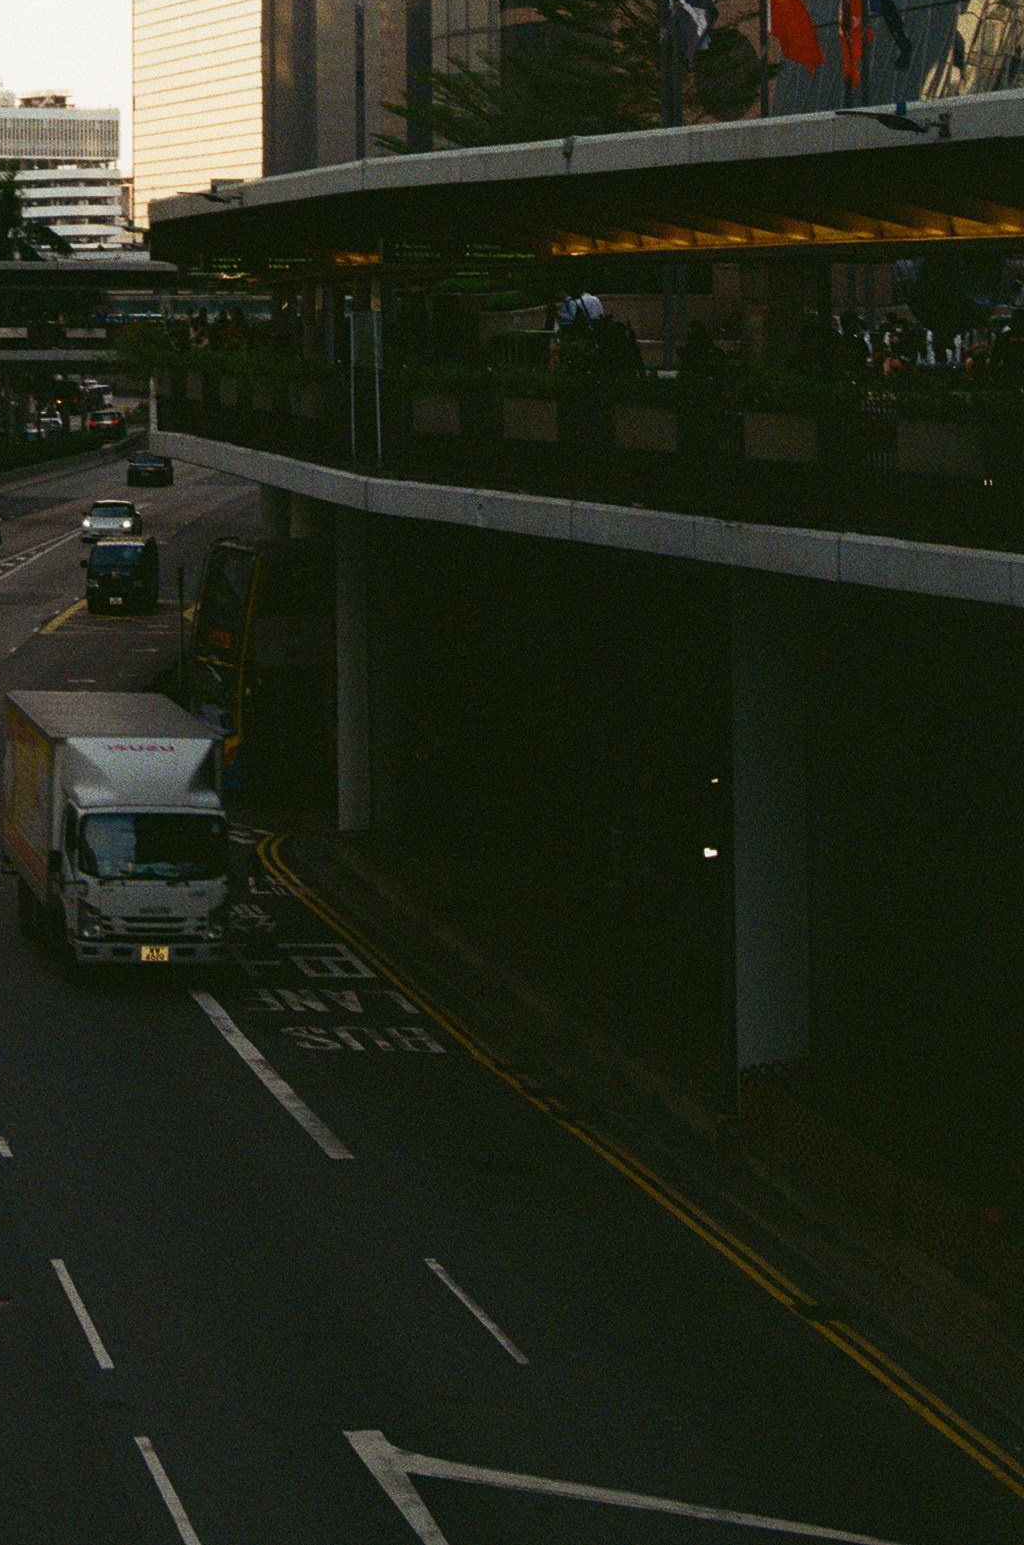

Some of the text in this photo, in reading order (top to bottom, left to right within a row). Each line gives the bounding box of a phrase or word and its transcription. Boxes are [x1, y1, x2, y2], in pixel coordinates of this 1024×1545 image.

[107, 744, 175, 753] ISUZU
[246, 988, 420, 1014] LANE
[279, 1026, 448, 1054] BUS
